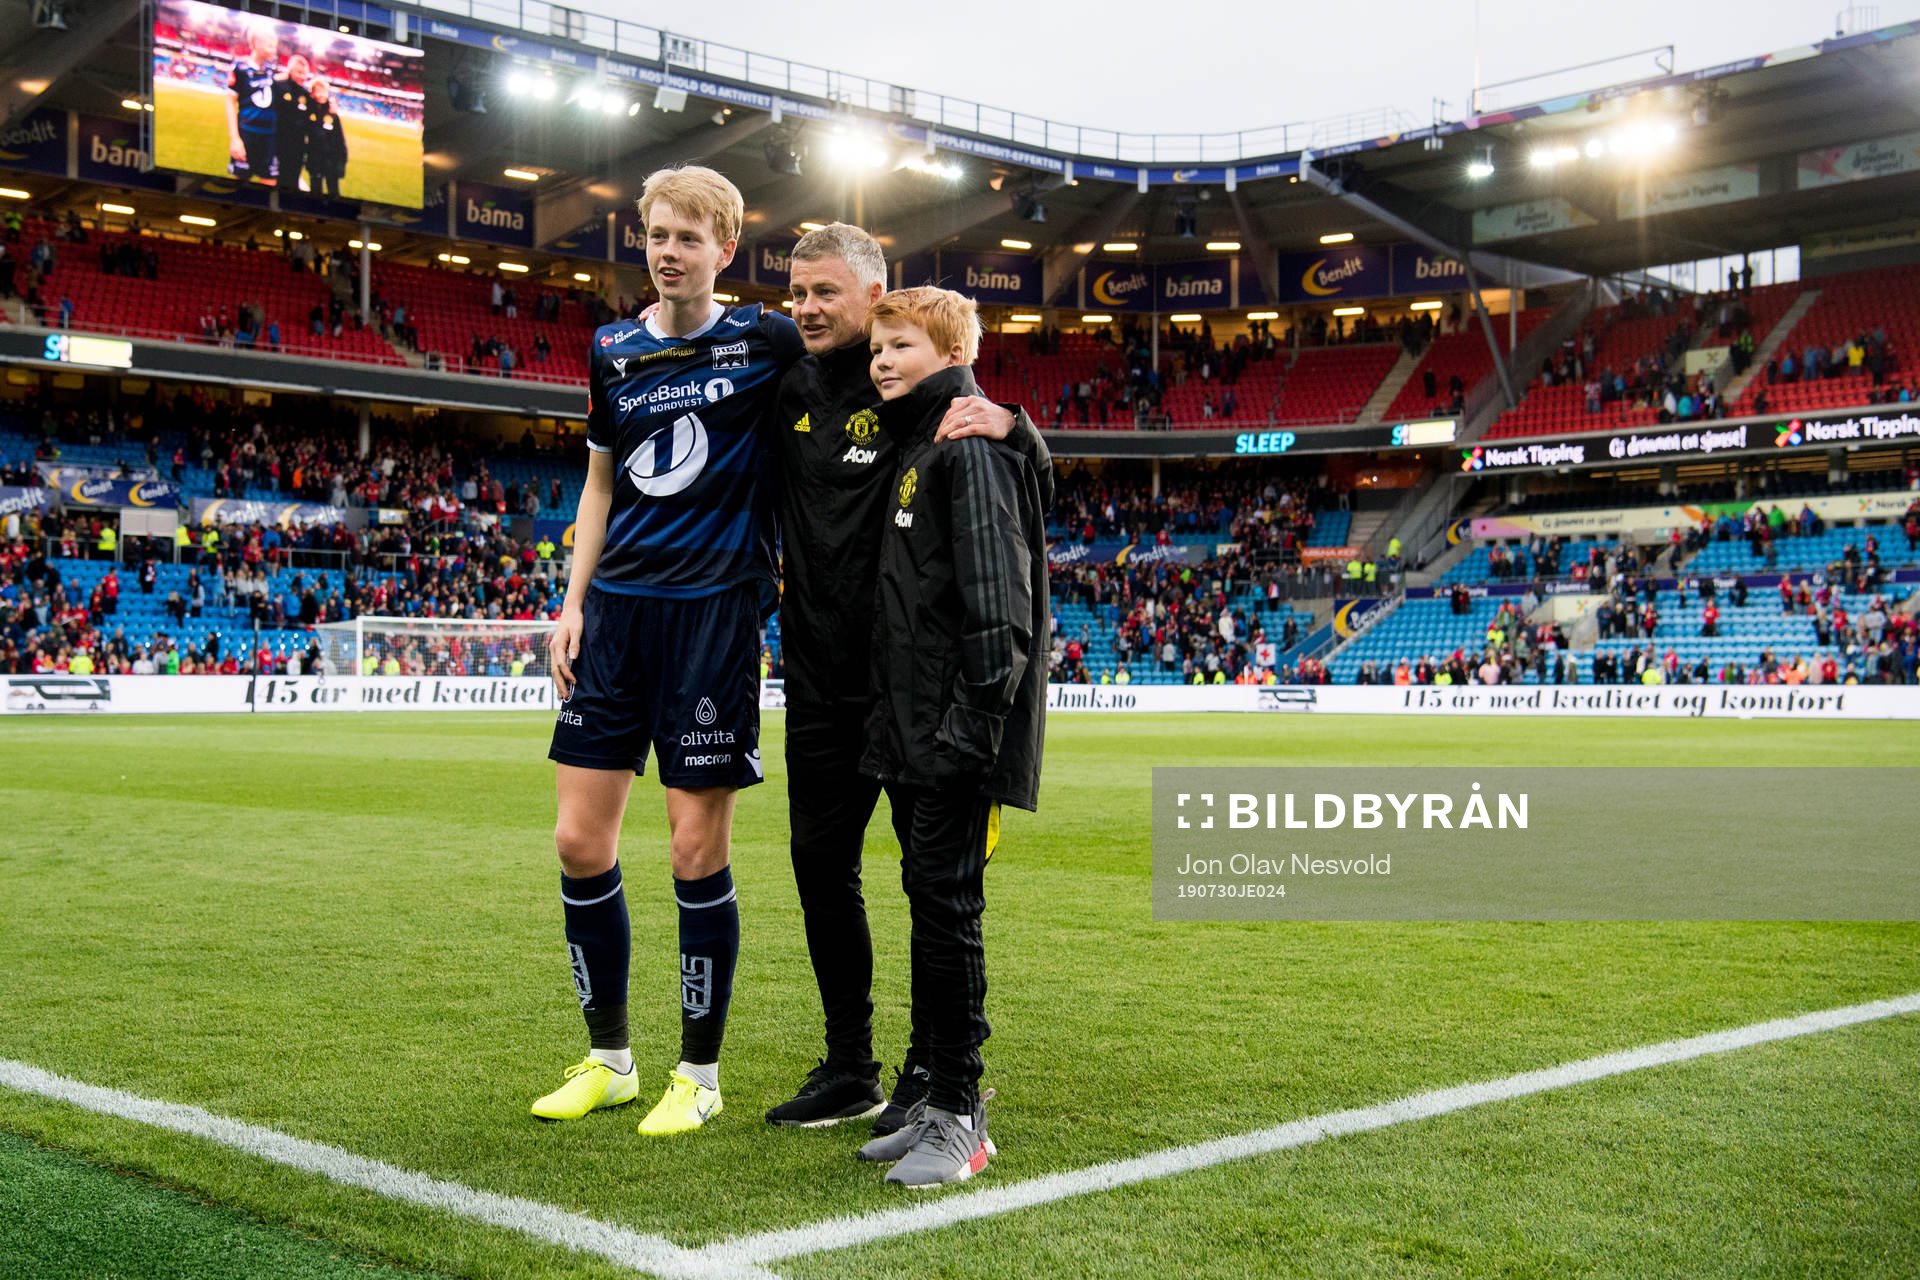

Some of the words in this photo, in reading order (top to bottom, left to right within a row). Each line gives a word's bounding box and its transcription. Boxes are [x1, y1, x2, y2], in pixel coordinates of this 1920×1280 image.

[466, 201, 525, 231] bama
[965, 266, 1021, 291] bama
[1317, 256, 1364, 286] Bendit
[1107, 273, 1148, 297] Bendit
[1165, 276, 1223, 298] bama
[618, 381, 702, 412] SpareBank
[649, 396, 704, 414] NORDVEST
[1805, 418, 1860, 442] Norsk
[1860, 412, 1920, 440] Tippin
[1235, 431, 1297, 454] SLEEP
[1485, 446, 1529, 468] Norsk
[1528, 442, 1585, 466] Tipping
[0, 486, 46, 513] endit
[310, 676, 348, 704] år
[362, 680, 421, 704] med
[433, 680, 547, 704] kvalitet
[1489, 689, 1542, 709] med
[1552, 689, 1662, 710] kvalitet
[1673, 693, 1708, 718] og
[1720, 688, 1847, 713] komfort
[680, 729, 736, 747] olivita
[684, 752, 732, 767] macron
